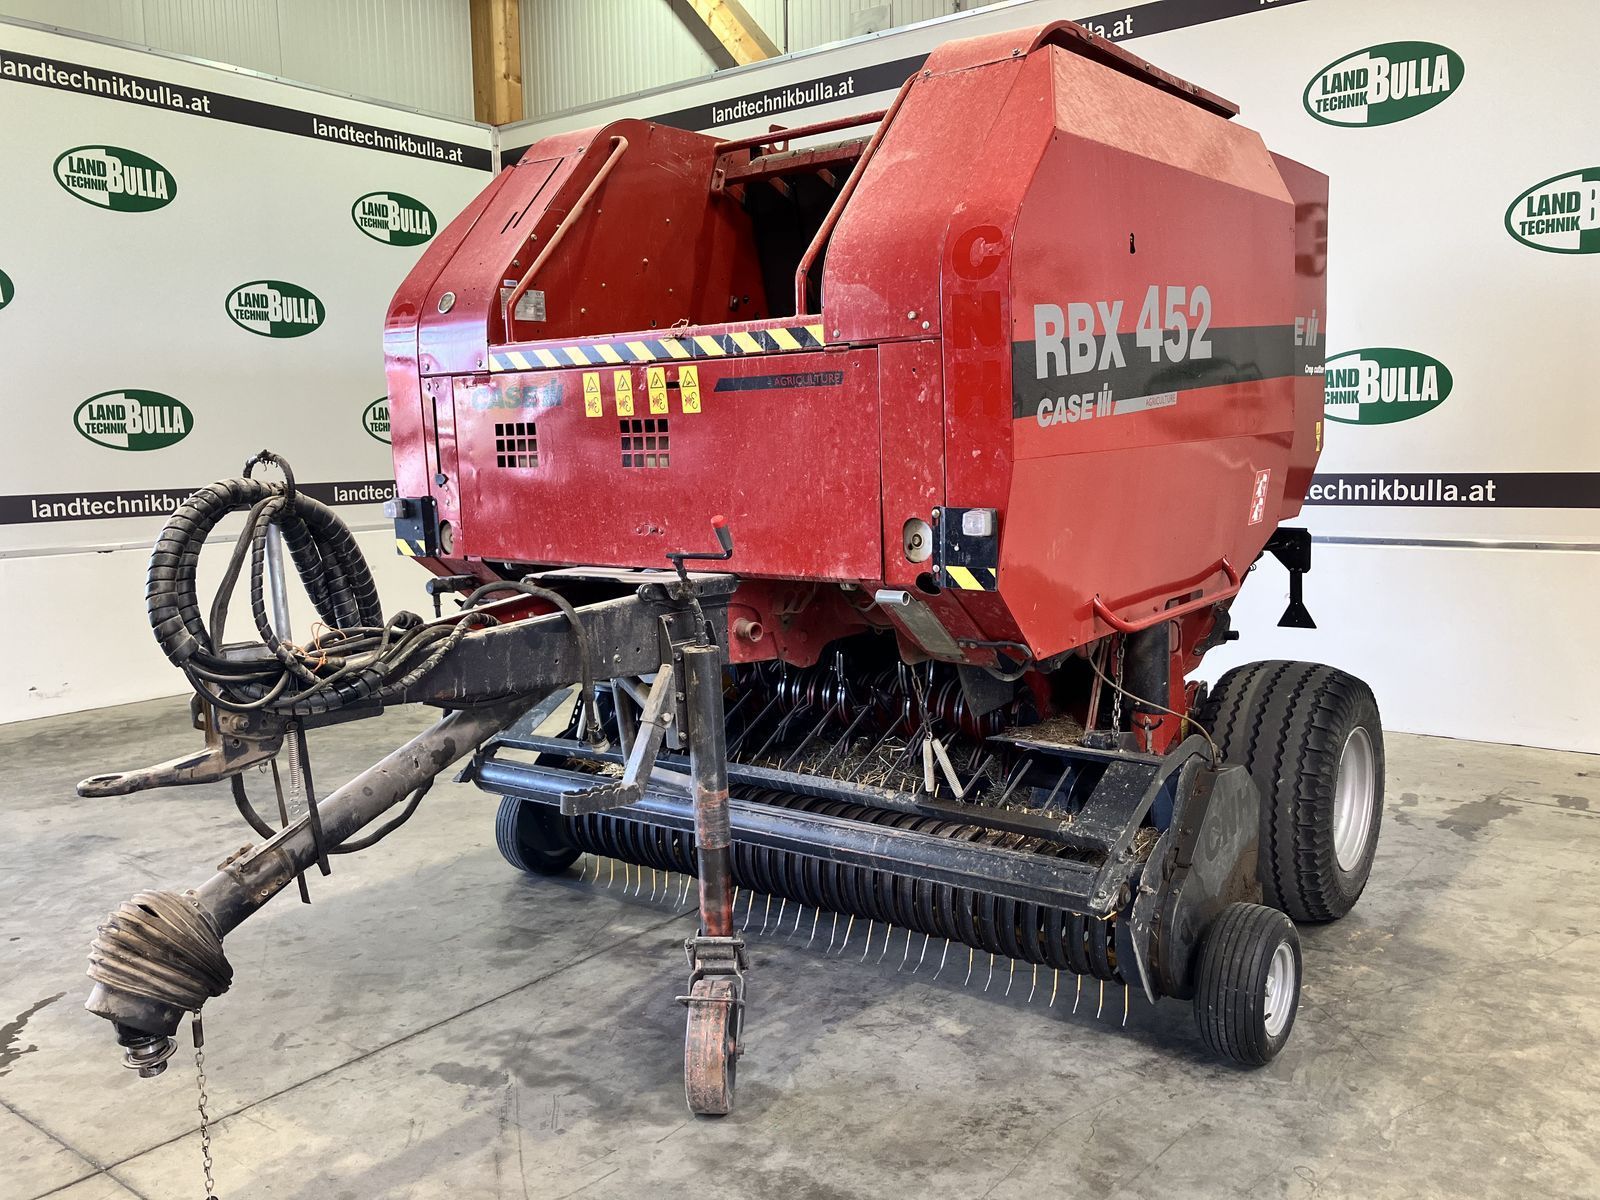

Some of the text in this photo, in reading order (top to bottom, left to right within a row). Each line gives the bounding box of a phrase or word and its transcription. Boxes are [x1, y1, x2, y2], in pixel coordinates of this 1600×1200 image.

[1322, 68, 1368, 95] LAND
[1368, 54, 1450, 105] BULLA
[712, 76, 854, 124] landtechnikbulla.at
[1316, 91, 1369, 113] TECHNIK
[313, 118, 463, 163] landtechnikbulla.at
[68, 156, 107, 178] LAND
[106, 155, 169, 200] BULLA
[64, 174, 108, 191] TECHNIK
[362, 201, 389, 218] LAND
[1527, 191, 1581, 217] LAND
[359, 216, 389, 230] TECHNIK
[388, 200, 431, 235] BULLA
[1519, 216, 1580, 236] TECHNIK
[237, 292, 269, 309] LAND
[267, 288, 318, 325] BULLA
[234, 309, 270, 321] TECHNIK
[1034, 285, 1212, 379] RBX 452
[774, 372, 840, 386] AGRICULTURE
[1359, 359, 1439, 404] BULLA
[88, 404, 126, 421] LAND
[125, 398, 185, 435] BULLA
[1036, 393, 1094, 428] CASE
[1145, 394, 1176, 407] AGRICULTURE
[85, 422, 127, 434] TECHNIK
[1304, 479, 1496, 502] echnikbulla.at
[32, 493, 193, 518] landtechnikb
